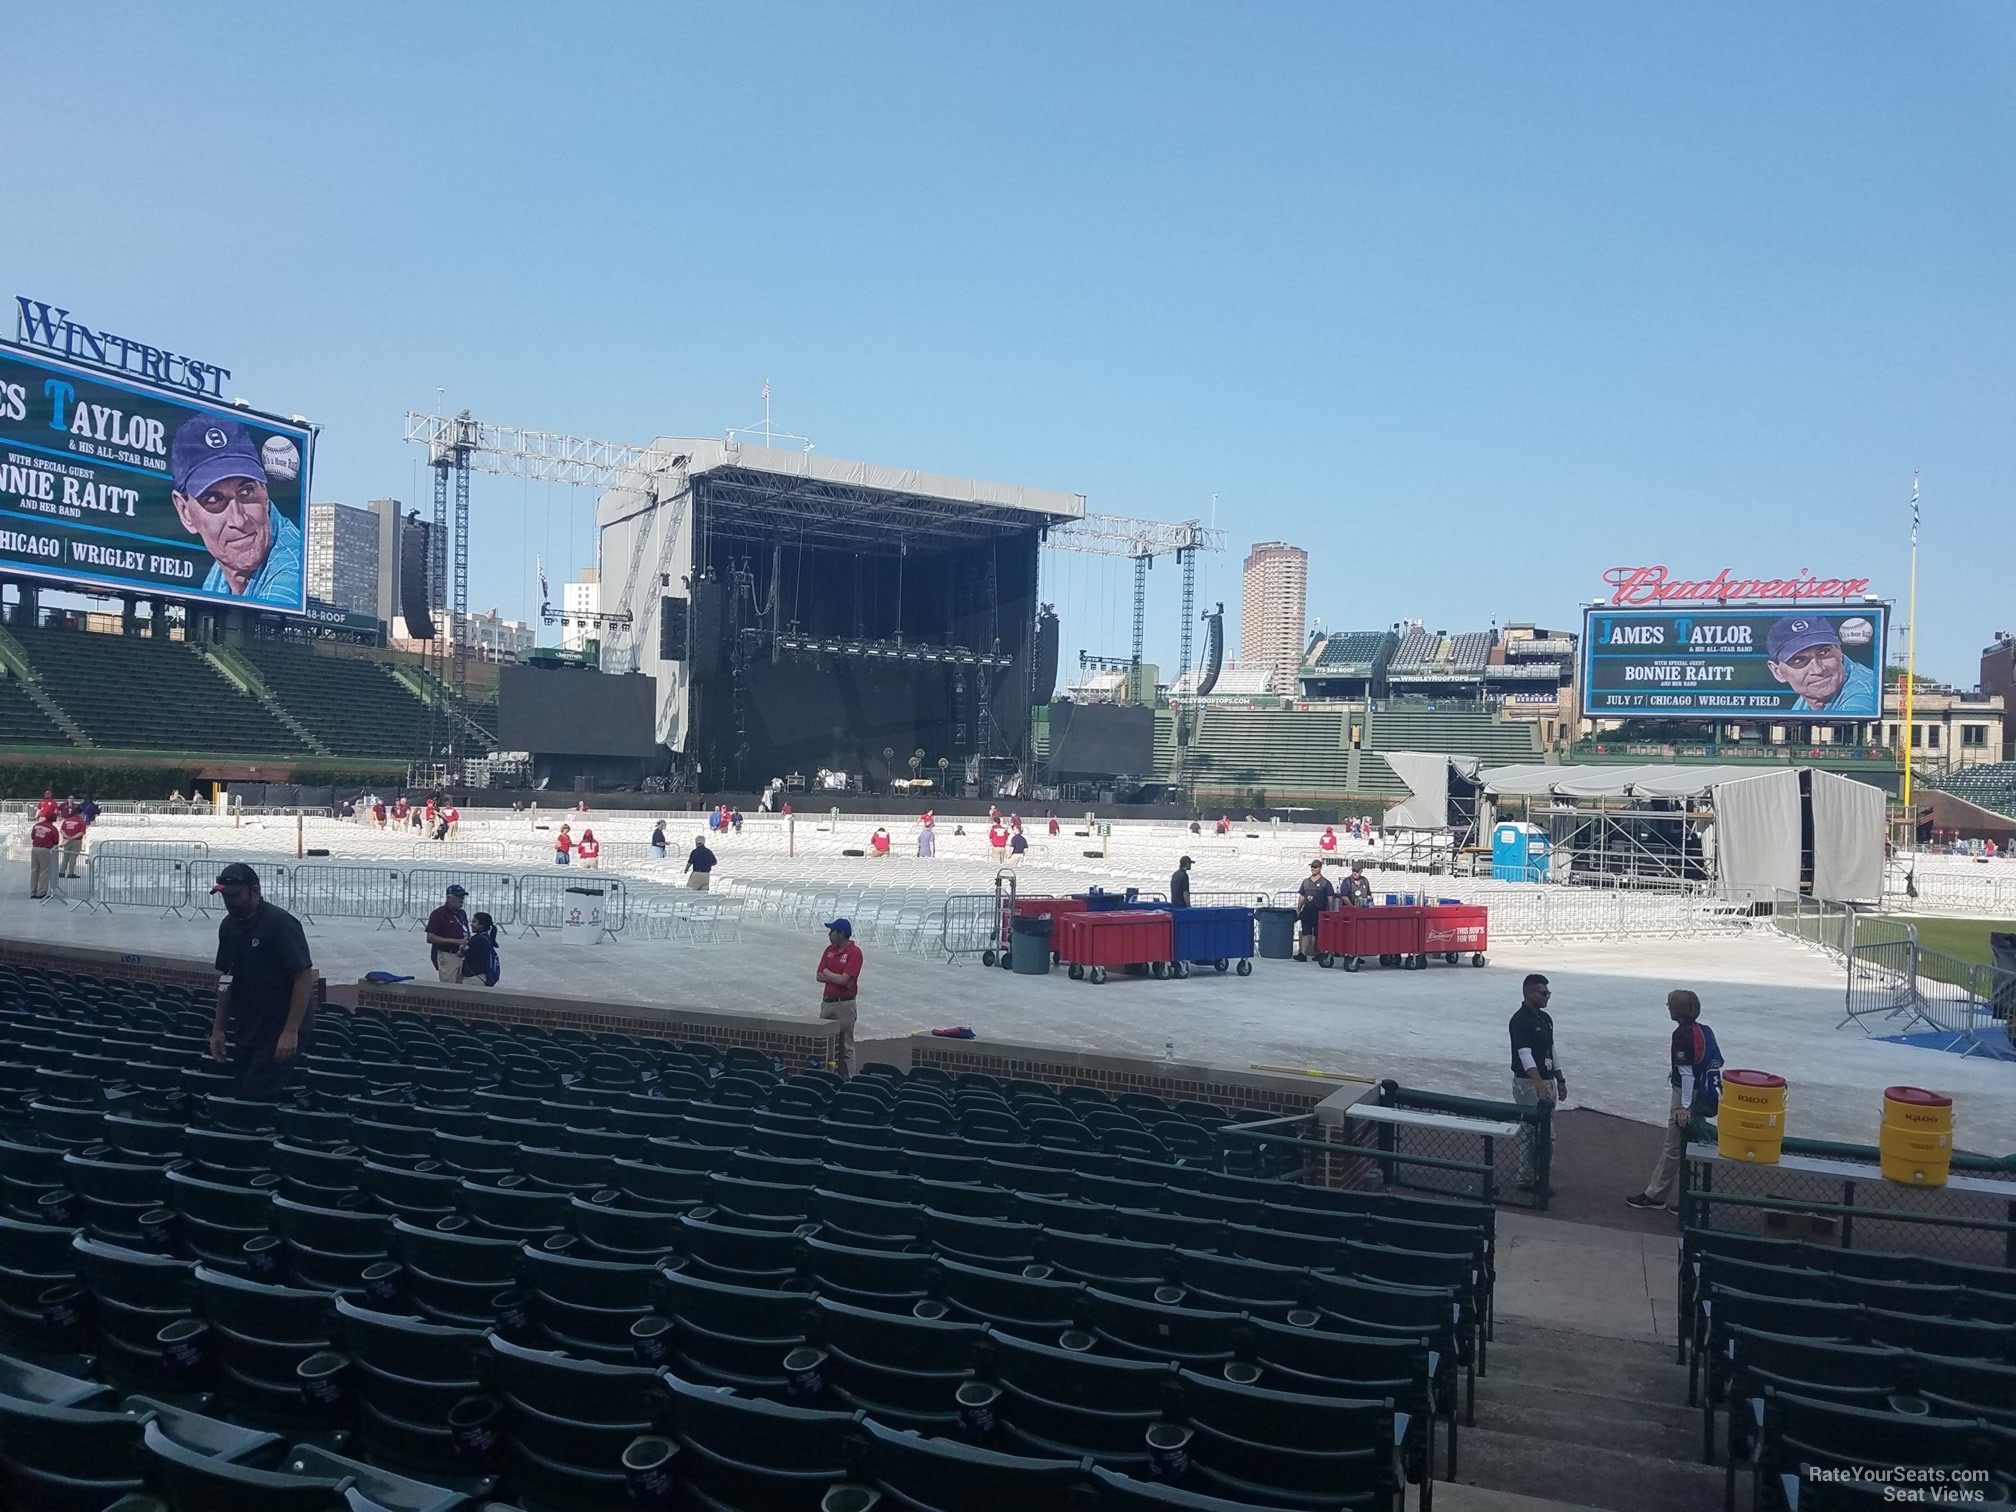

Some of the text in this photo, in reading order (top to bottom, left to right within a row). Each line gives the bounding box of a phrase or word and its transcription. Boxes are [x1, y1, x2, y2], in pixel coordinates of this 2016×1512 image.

[15, 294, 231, 398] WINTRUST
[44, 378, 167, 455] TAYLOR
[8, 452, 95, 480] WITH SPECIAL GUEST
[68, 439, 167, 471] & HIS ALL-STAR BAND
[20, 498, 81, 518] AND HER BAND
[62, 476, 139, 517] RAITT
[0, 530, 194, 579] HICAGO WRIGLEY FIELD
[1602, 565, 1870, 605] Budweiser
[1599, 619, 1753, 645] JAMES TAYLOR
[1625, 666, 1734, 681] BONNIE RAITT
[1606, 695, 1780, 707] JULY 17 CHICAGO WRIGLEY FIELD
[1456, 927, 1469, 935] THIS
[1469, 926, 1485, 935] BUD'S
[1457, 935, 1468, 943] FOR
